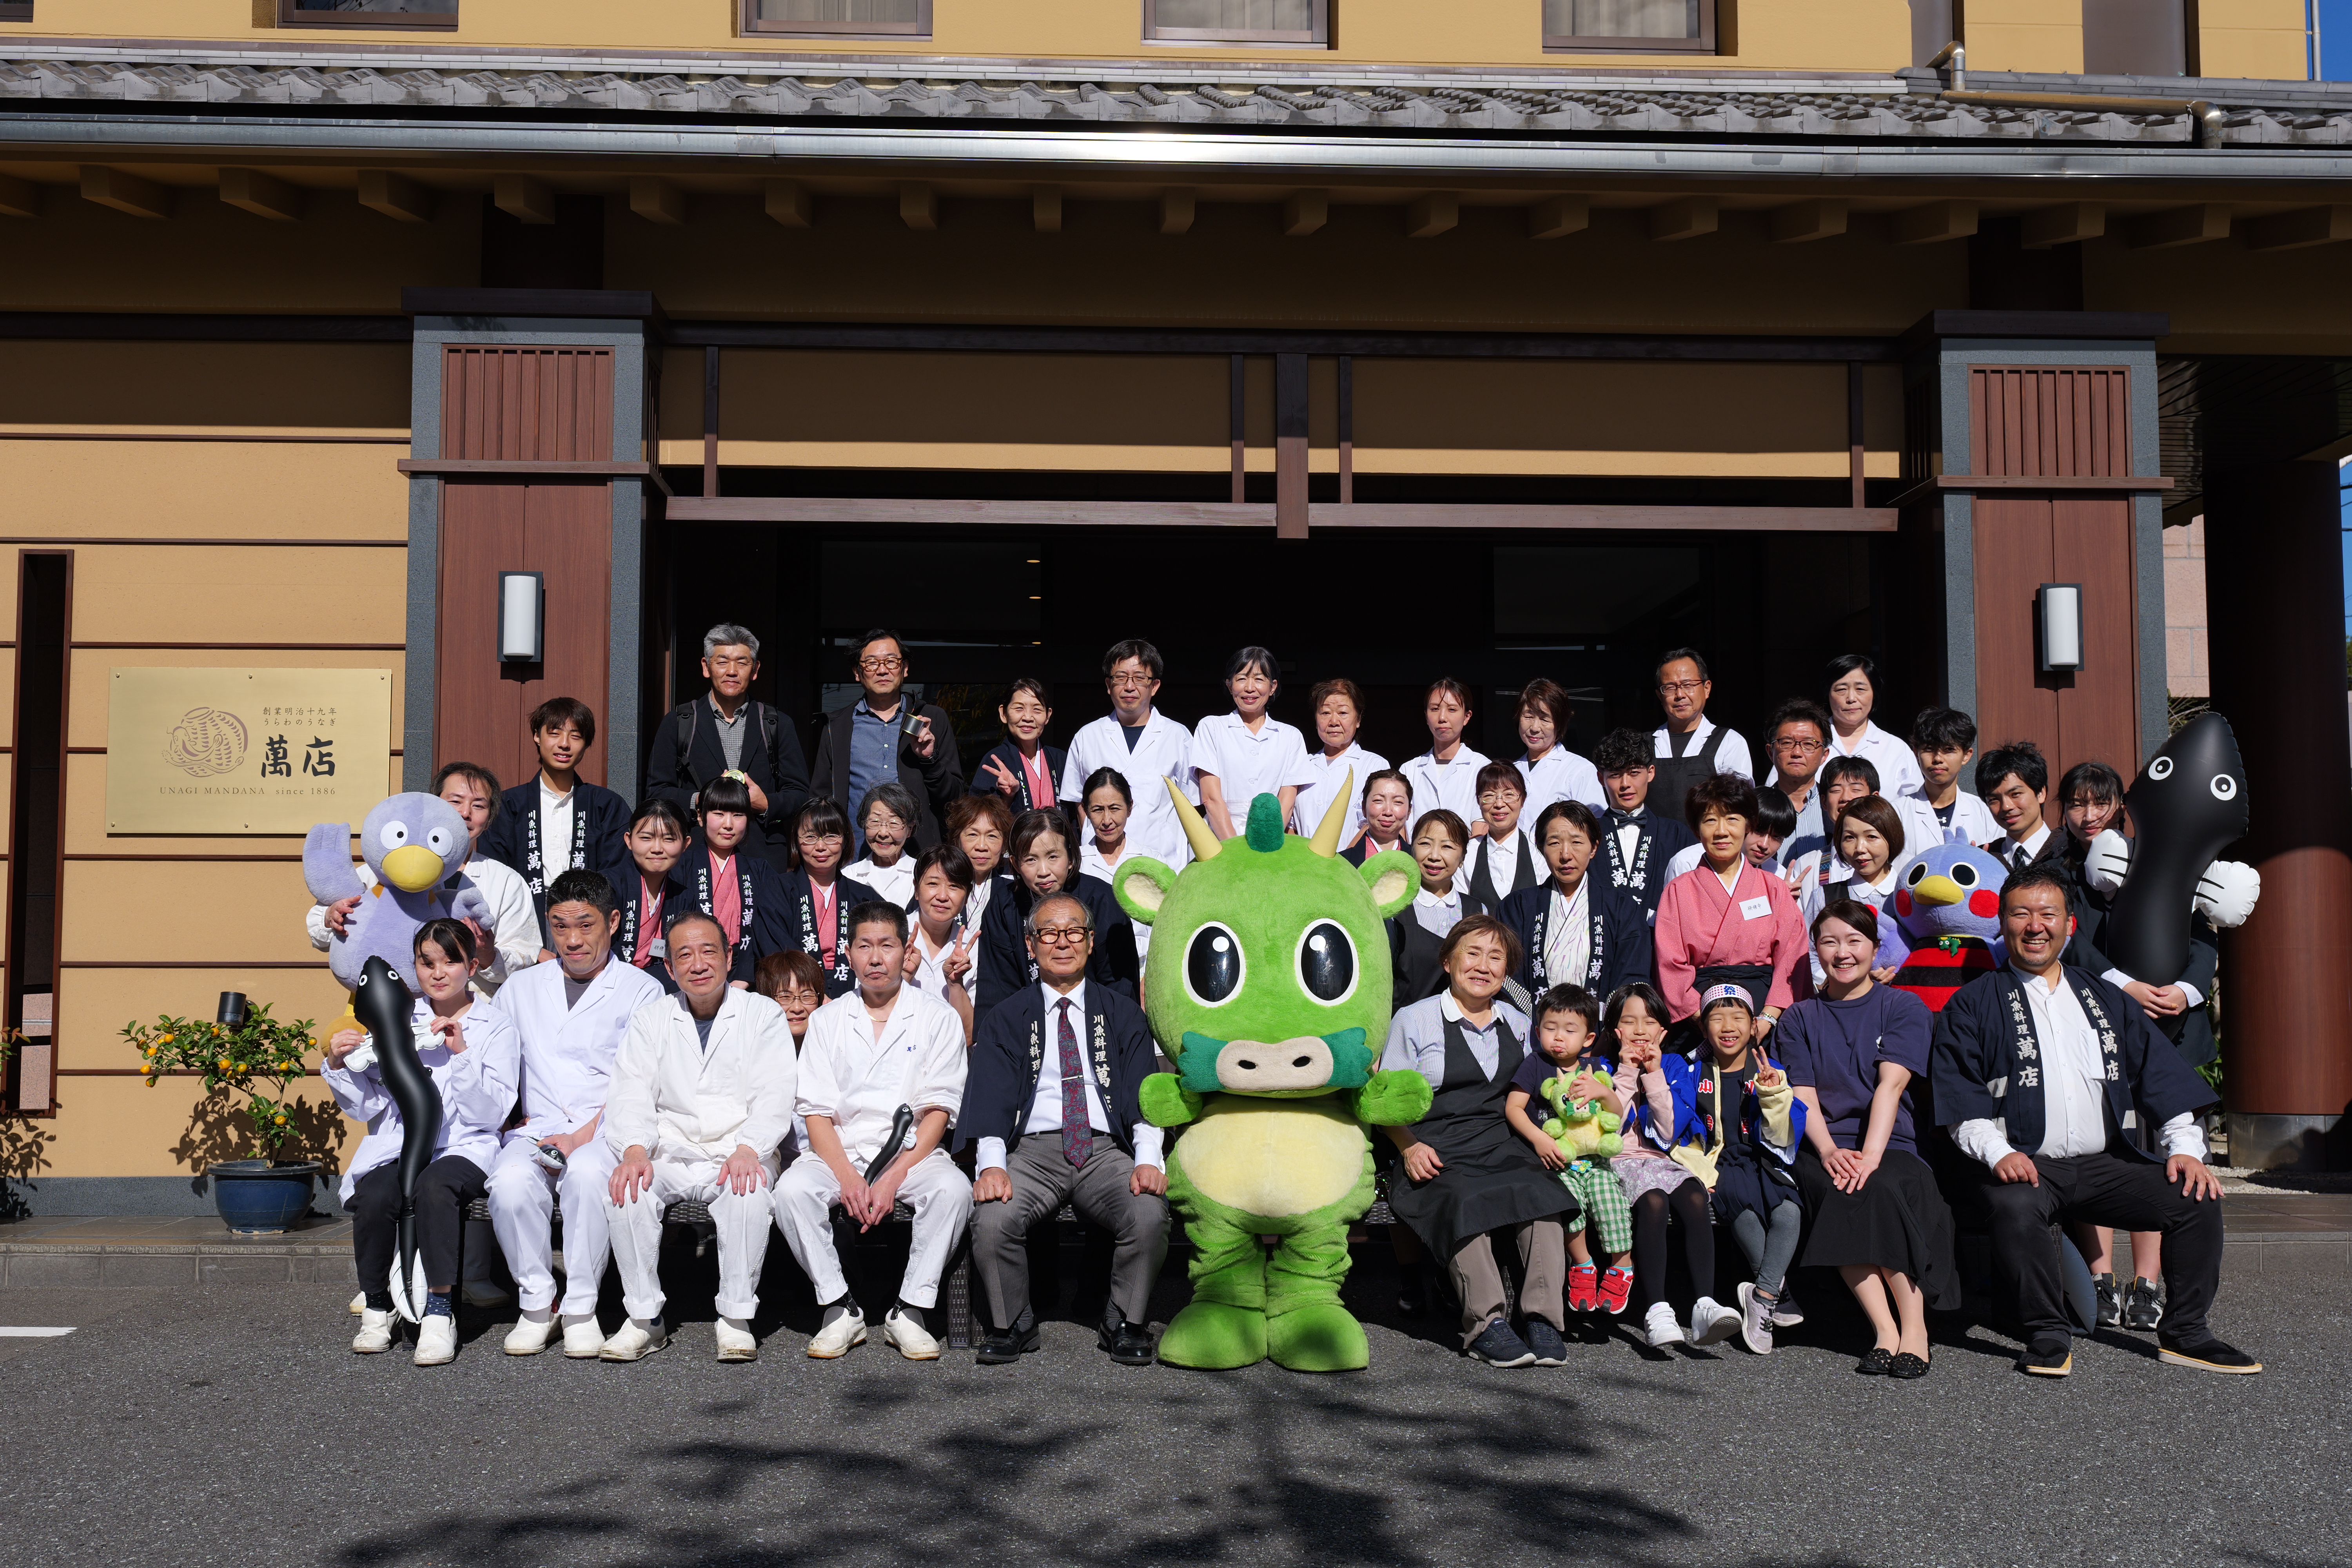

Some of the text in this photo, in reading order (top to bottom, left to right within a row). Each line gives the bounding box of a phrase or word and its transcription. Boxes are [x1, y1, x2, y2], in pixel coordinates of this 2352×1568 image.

[262, 707, 337, 716] 創業明治十九年
[261, 734, 336, 778] 萬店
[311, 787, 336, 795] 1886
[1724, 985, 1736, 995] 祭
